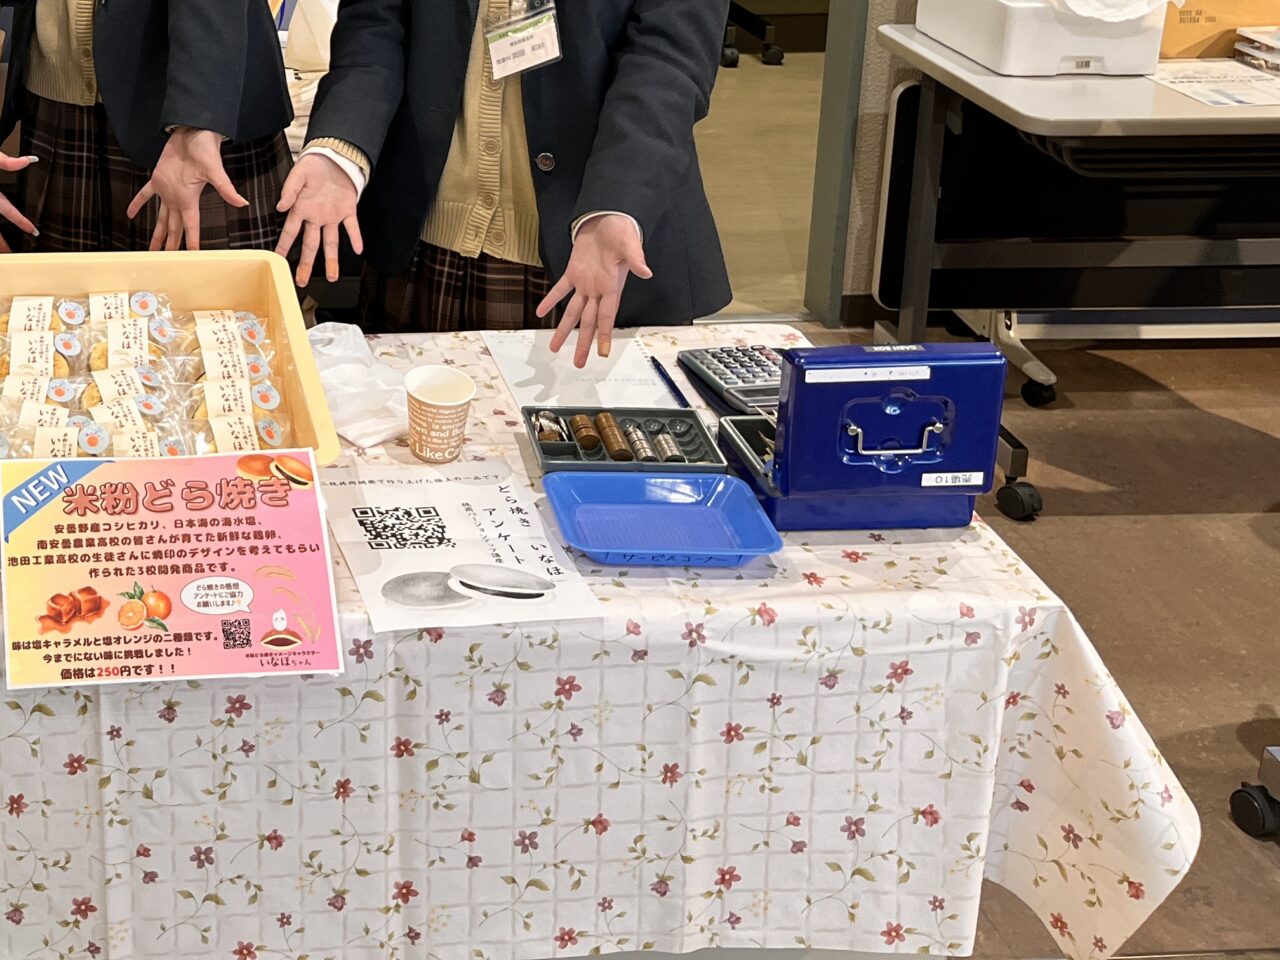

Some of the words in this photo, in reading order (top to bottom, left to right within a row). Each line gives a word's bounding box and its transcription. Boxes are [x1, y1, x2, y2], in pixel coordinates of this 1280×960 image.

[415, 443, 443, 460] Like
[10, 464, 70, 515] NEW
[63, 476, 292, 517] 米粉どら焼き
[483, 507, 525, 565] アンケート
